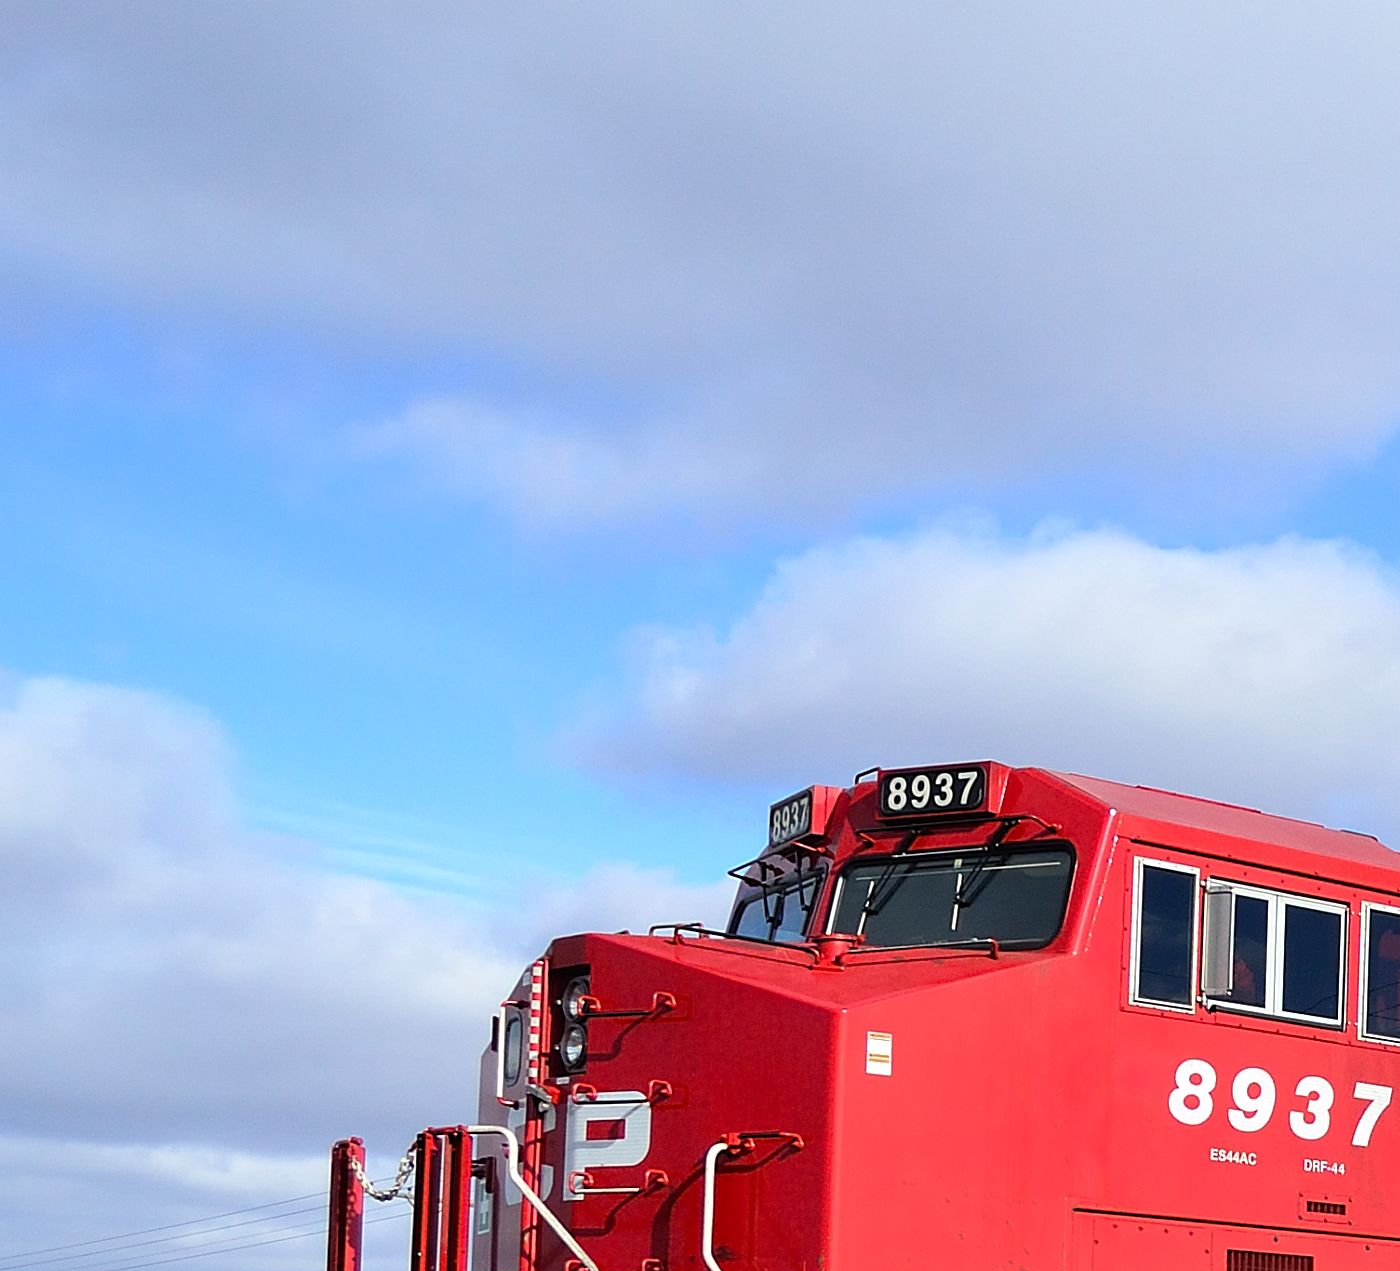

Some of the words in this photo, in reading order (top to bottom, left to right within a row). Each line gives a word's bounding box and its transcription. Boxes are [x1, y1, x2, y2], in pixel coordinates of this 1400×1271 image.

[888, 771, 978, 811] 8937
[772, 797, 809, 842] 8937
[1168, 1058, 1394, 1148] 8937
[1210, 1148, 1257, 1166] ES44AC
[1303, 1158, 1346, 1176] DRF-44
